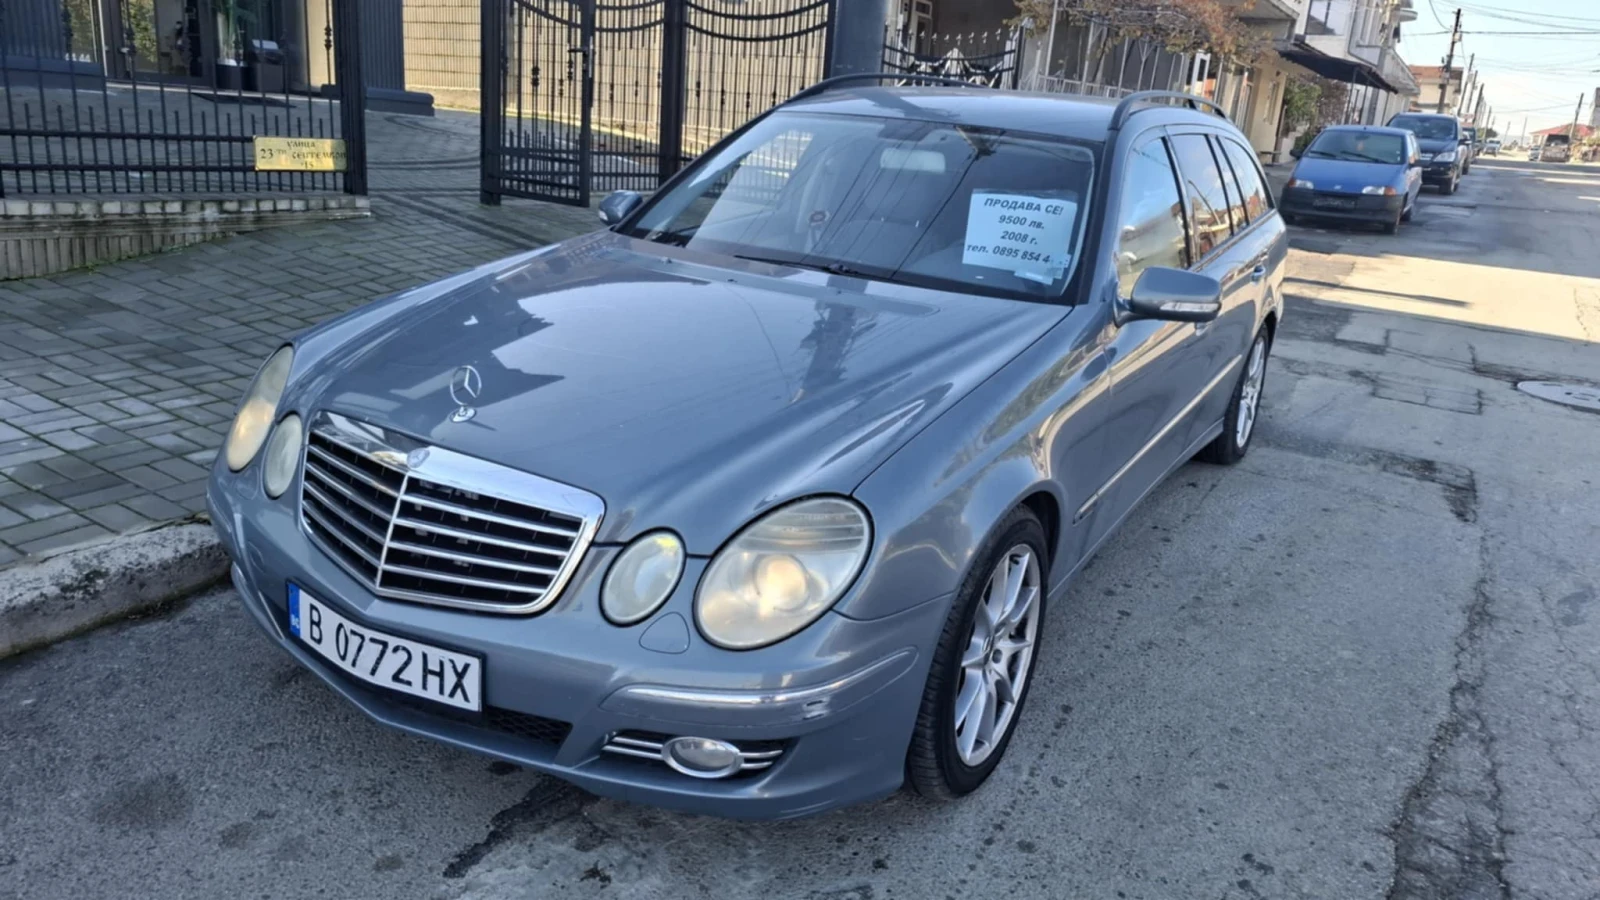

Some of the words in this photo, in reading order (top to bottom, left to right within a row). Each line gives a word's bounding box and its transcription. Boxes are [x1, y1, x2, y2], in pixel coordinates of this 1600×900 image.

[984, 198, 1041, 212] ПРОДАВА
[1044, 205, 1064, 216] СЕ!
[998, 215, 1027, 226] 9500
[1028, 220, 1045, 229] лв.
[1000, 231, 1029, 245] 2008
[966, 244, 988, 253] тел.
[992, 245, 1020, 258] 0895
[1020, 251, 1041, 262] 854
